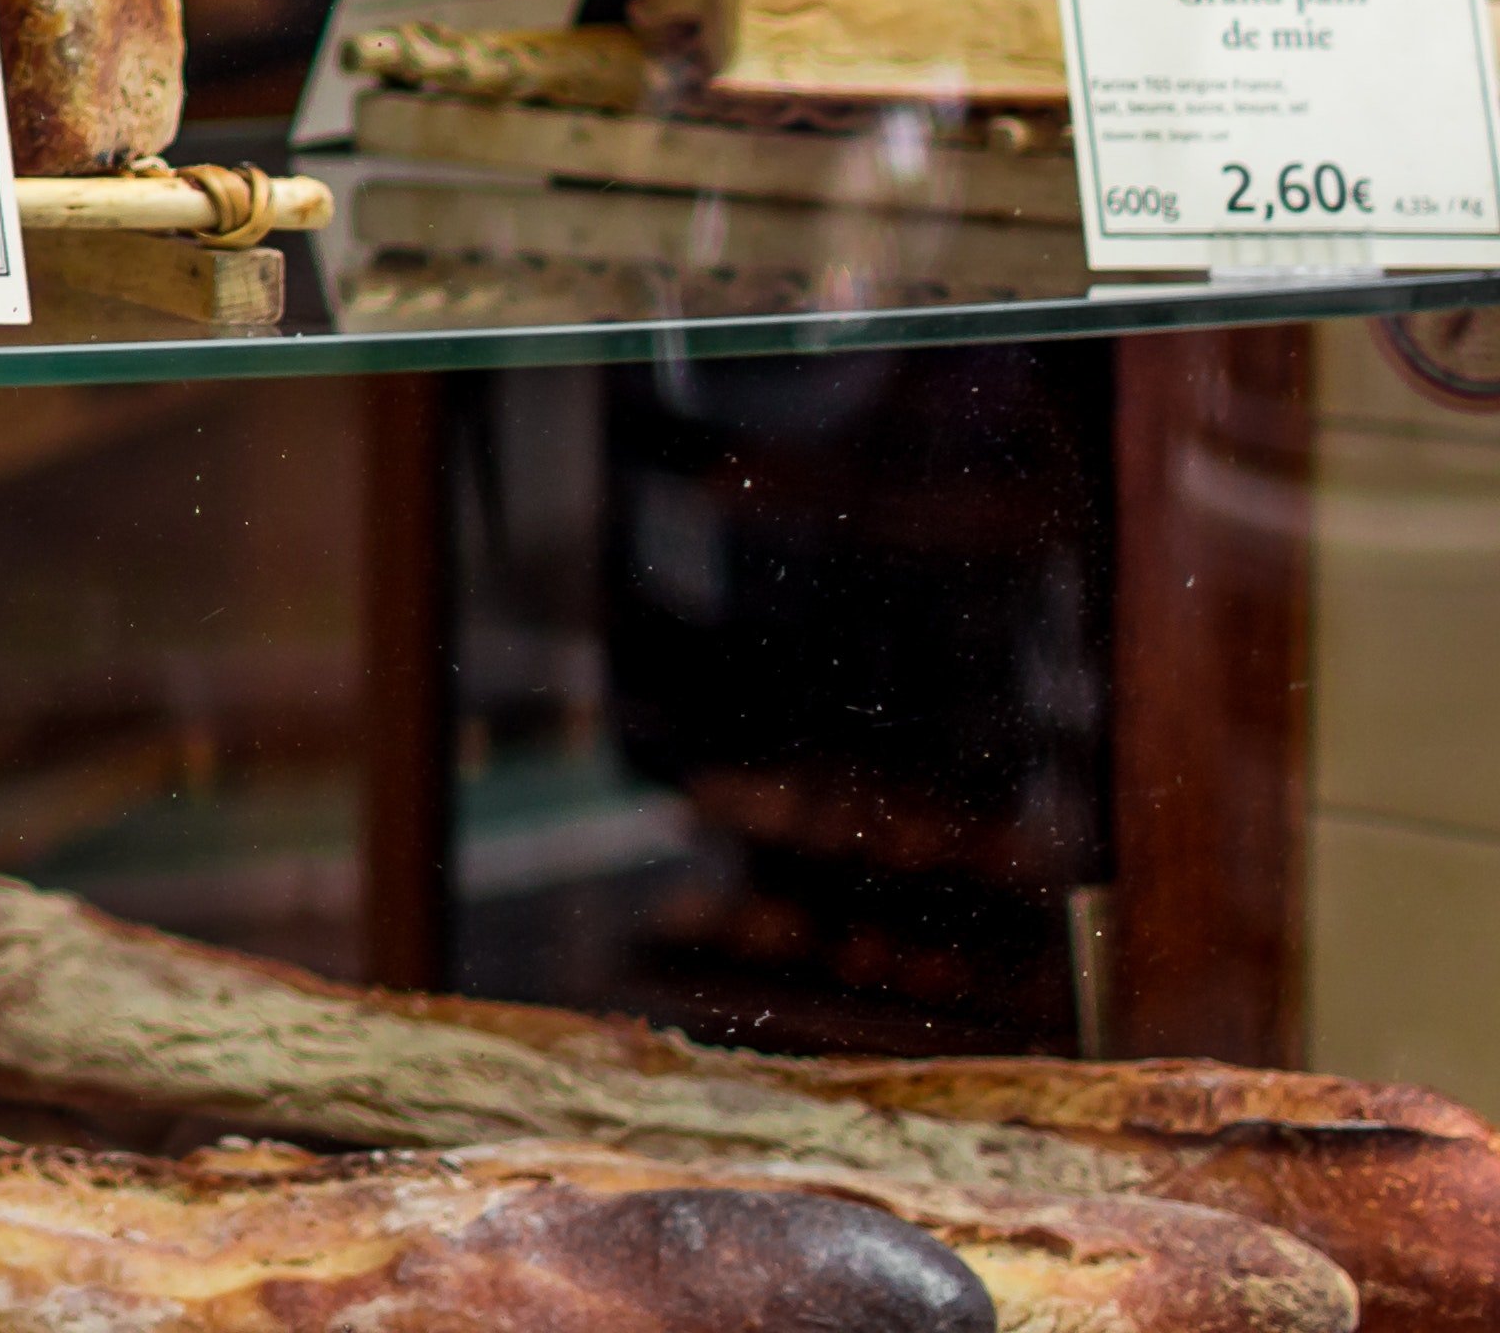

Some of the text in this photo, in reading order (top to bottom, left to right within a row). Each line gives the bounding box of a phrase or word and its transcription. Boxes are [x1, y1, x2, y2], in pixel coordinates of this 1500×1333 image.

[1222, 17, 1333, 50] de mie
[1106, 185, 1180, 223] 600g
[1221, 163, 1375, 221] 2,60€
